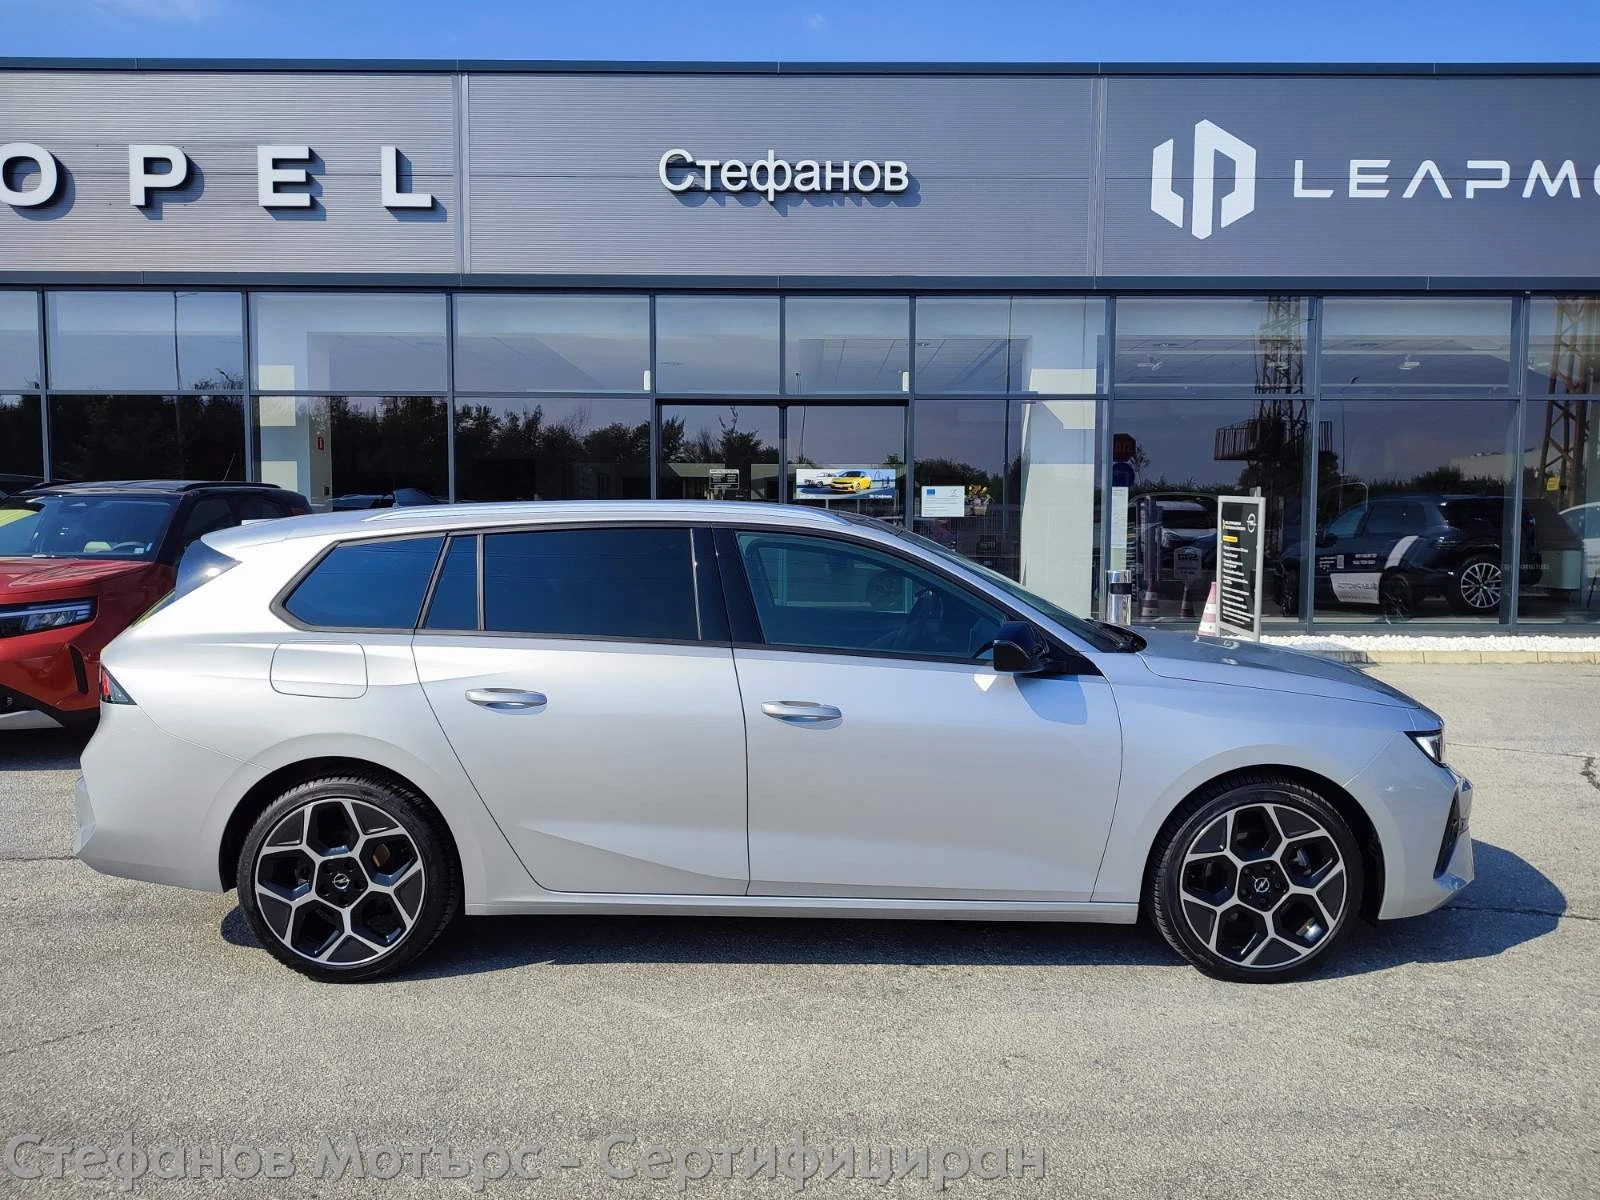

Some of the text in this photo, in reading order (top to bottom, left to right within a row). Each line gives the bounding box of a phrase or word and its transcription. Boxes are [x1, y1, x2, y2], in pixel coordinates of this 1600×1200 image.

[0, 142, 433, 207] OPEL
[658, 148, 909, 202] Стефанов
[1293, 158, 1600, 199] LEAPM
